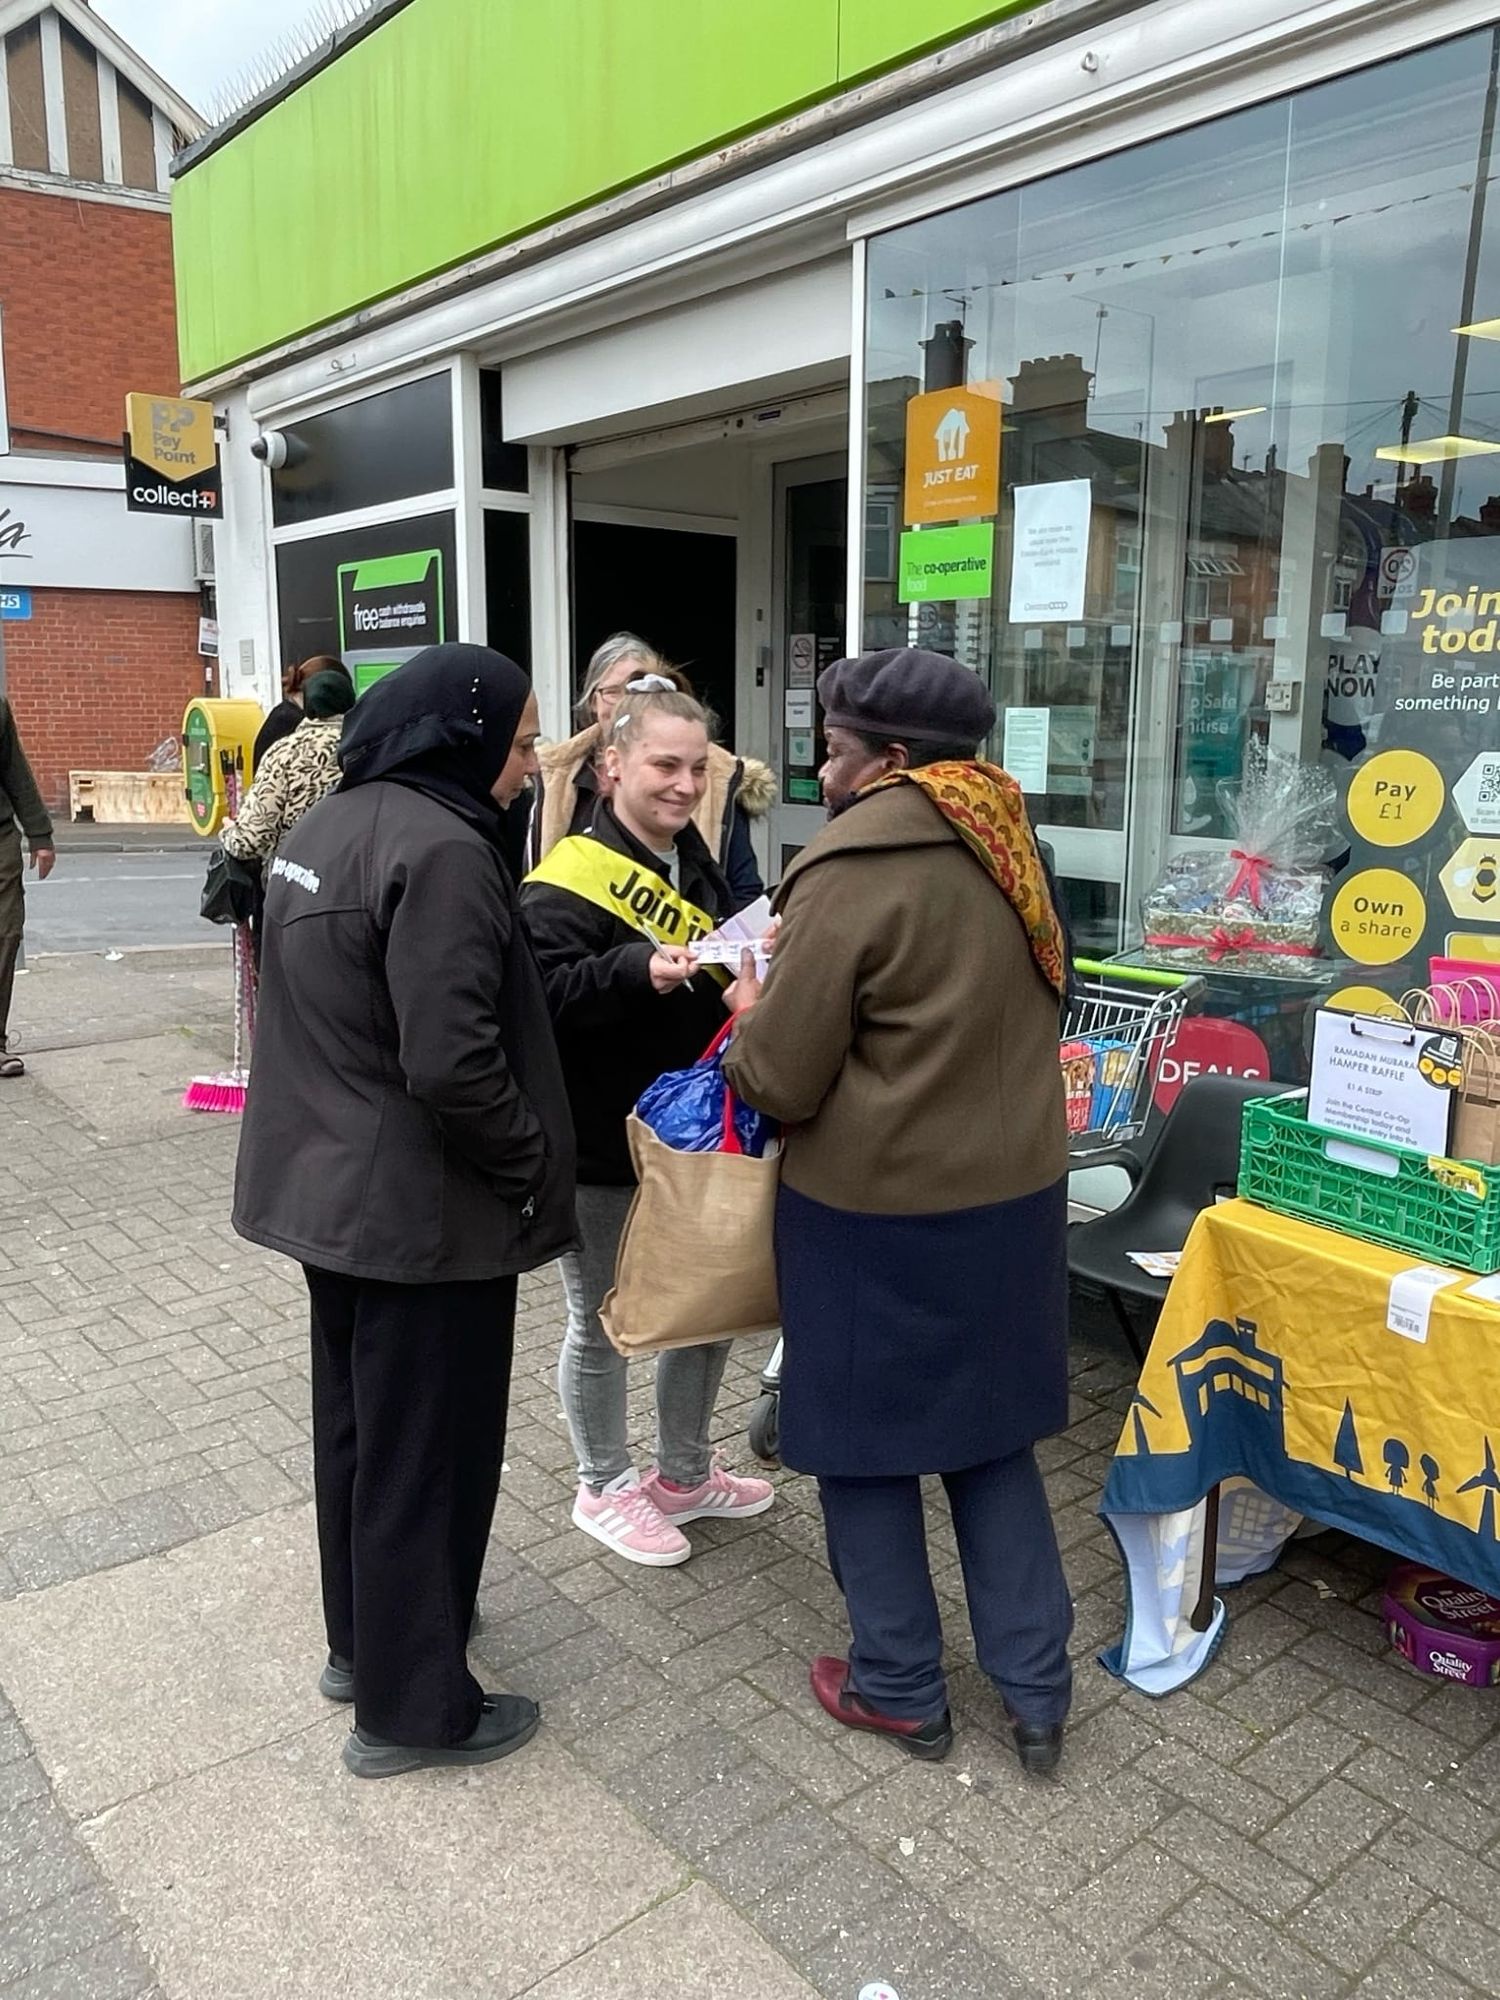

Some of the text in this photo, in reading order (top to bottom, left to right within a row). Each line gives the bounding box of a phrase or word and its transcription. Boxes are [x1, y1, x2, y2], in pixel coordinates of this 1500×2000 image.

[153, 431, 180, 451] Pay
[154, 448, 195, 464] Point
[922, 464, 980, 489] JUST EAT
[906, 557, 987, 576] The co-operative
[1411, 585, 1500, 619] Join
[353, 603, 379, 632] free
[1422, 619, 1500, 654] tod
[1327, 653, 1382, 675] PLAY
[1431, 673, 1500, 692] Be part
[1395, 695, 1491, 715] something
[1374, 781, 1417, 801] Pay
[1379, 802, 1403, 820] £1
[609, 870, 682, 937] Join
[1353, 897, 1404, 917] Own
[1340, 919, 1412, 939] a share
[1334, 1045, 1378, 1062] RAMADAN
[1379, 1055, 1418, 1070] MUBARA
[1329, 1056, 1405, 1082] HAMPER RAFFLE
[1421, 1590, 1488, 1609] Quality
[1440, 1602, 1497, 1620] Street
[1429, 1651, 1473, 1673] Quality
[1433, 1661, 1468, 1681] Street
